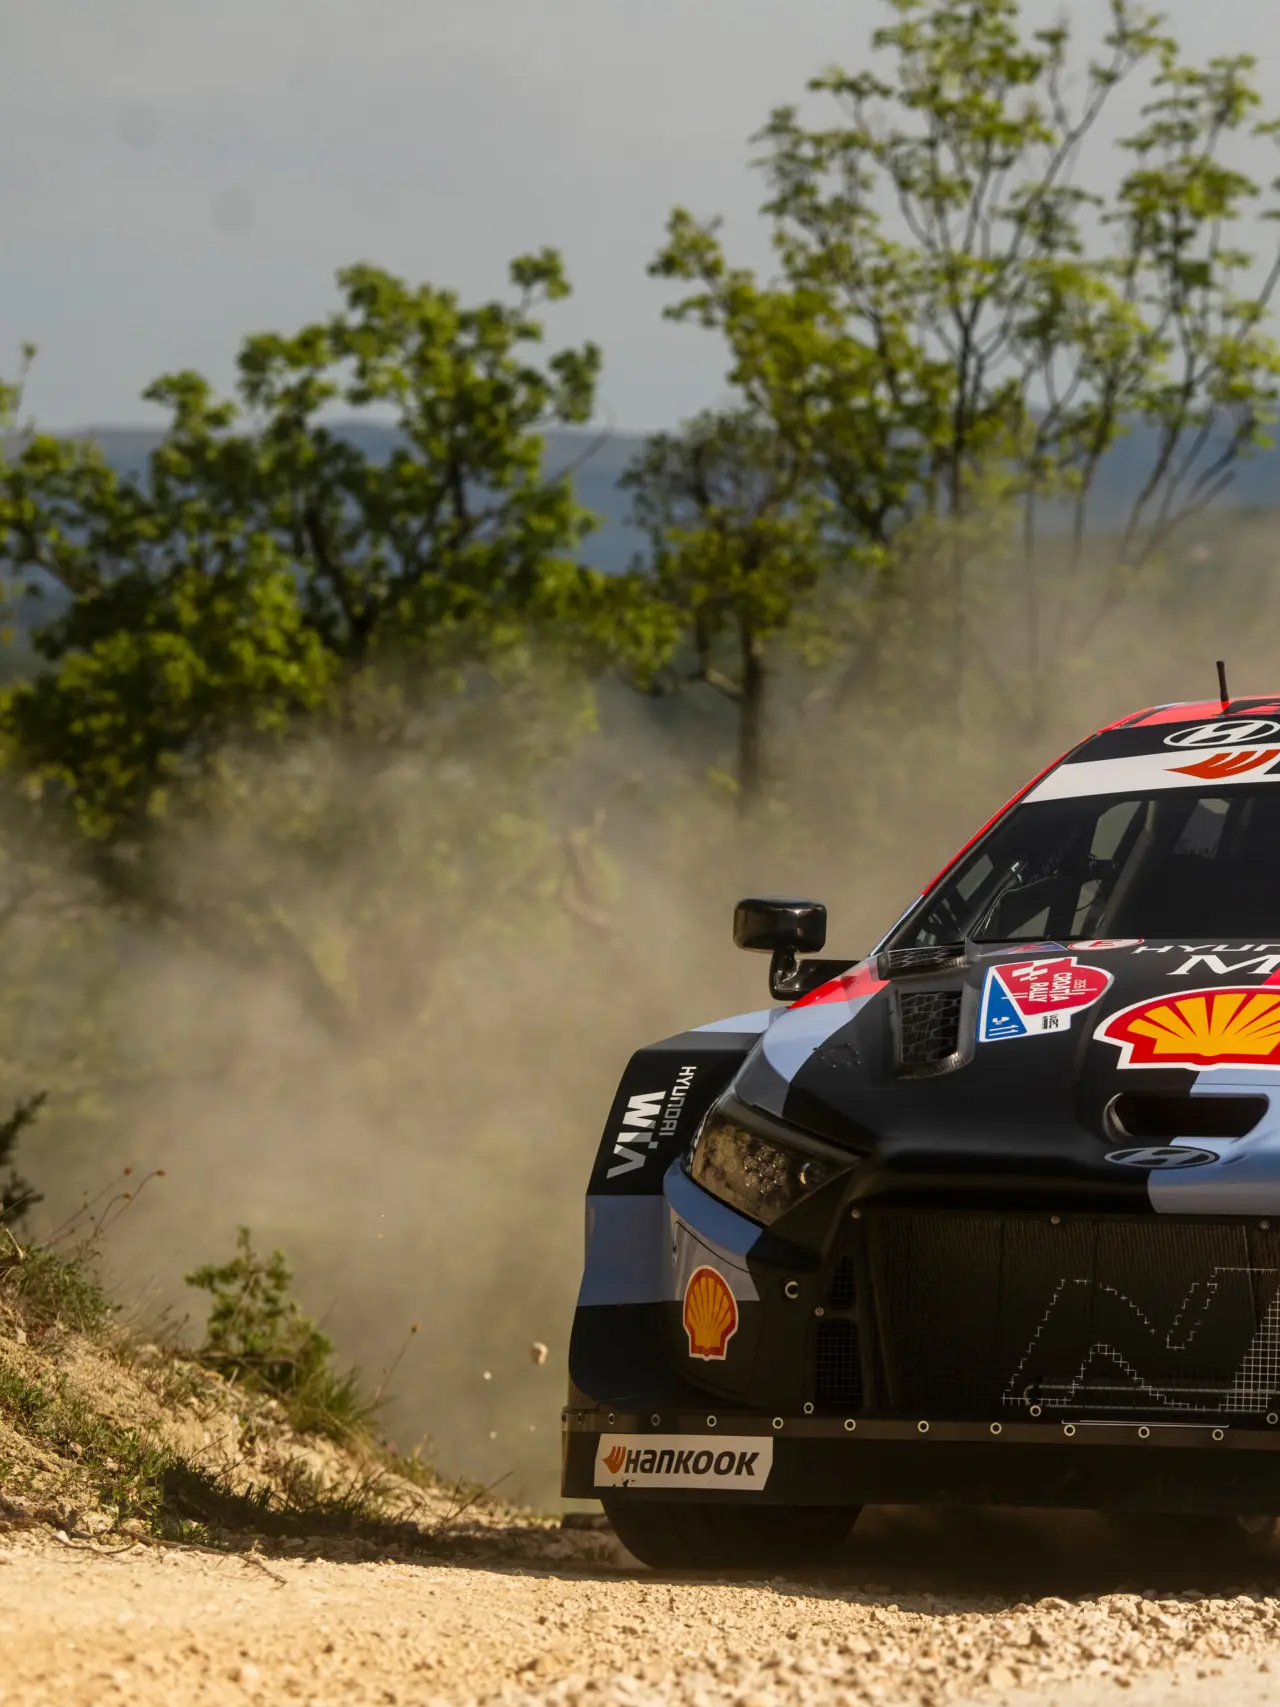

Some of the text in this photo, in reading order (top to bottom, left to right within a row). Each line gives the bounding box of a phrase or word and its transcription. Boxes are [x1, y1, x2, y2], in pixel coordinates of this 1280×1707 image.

[1028, 982, 1049, 1002] RALLY
[1050, 972, 1073, 1002] CROATIA
[659, 1066, 697, 1135] HYUNDAI
